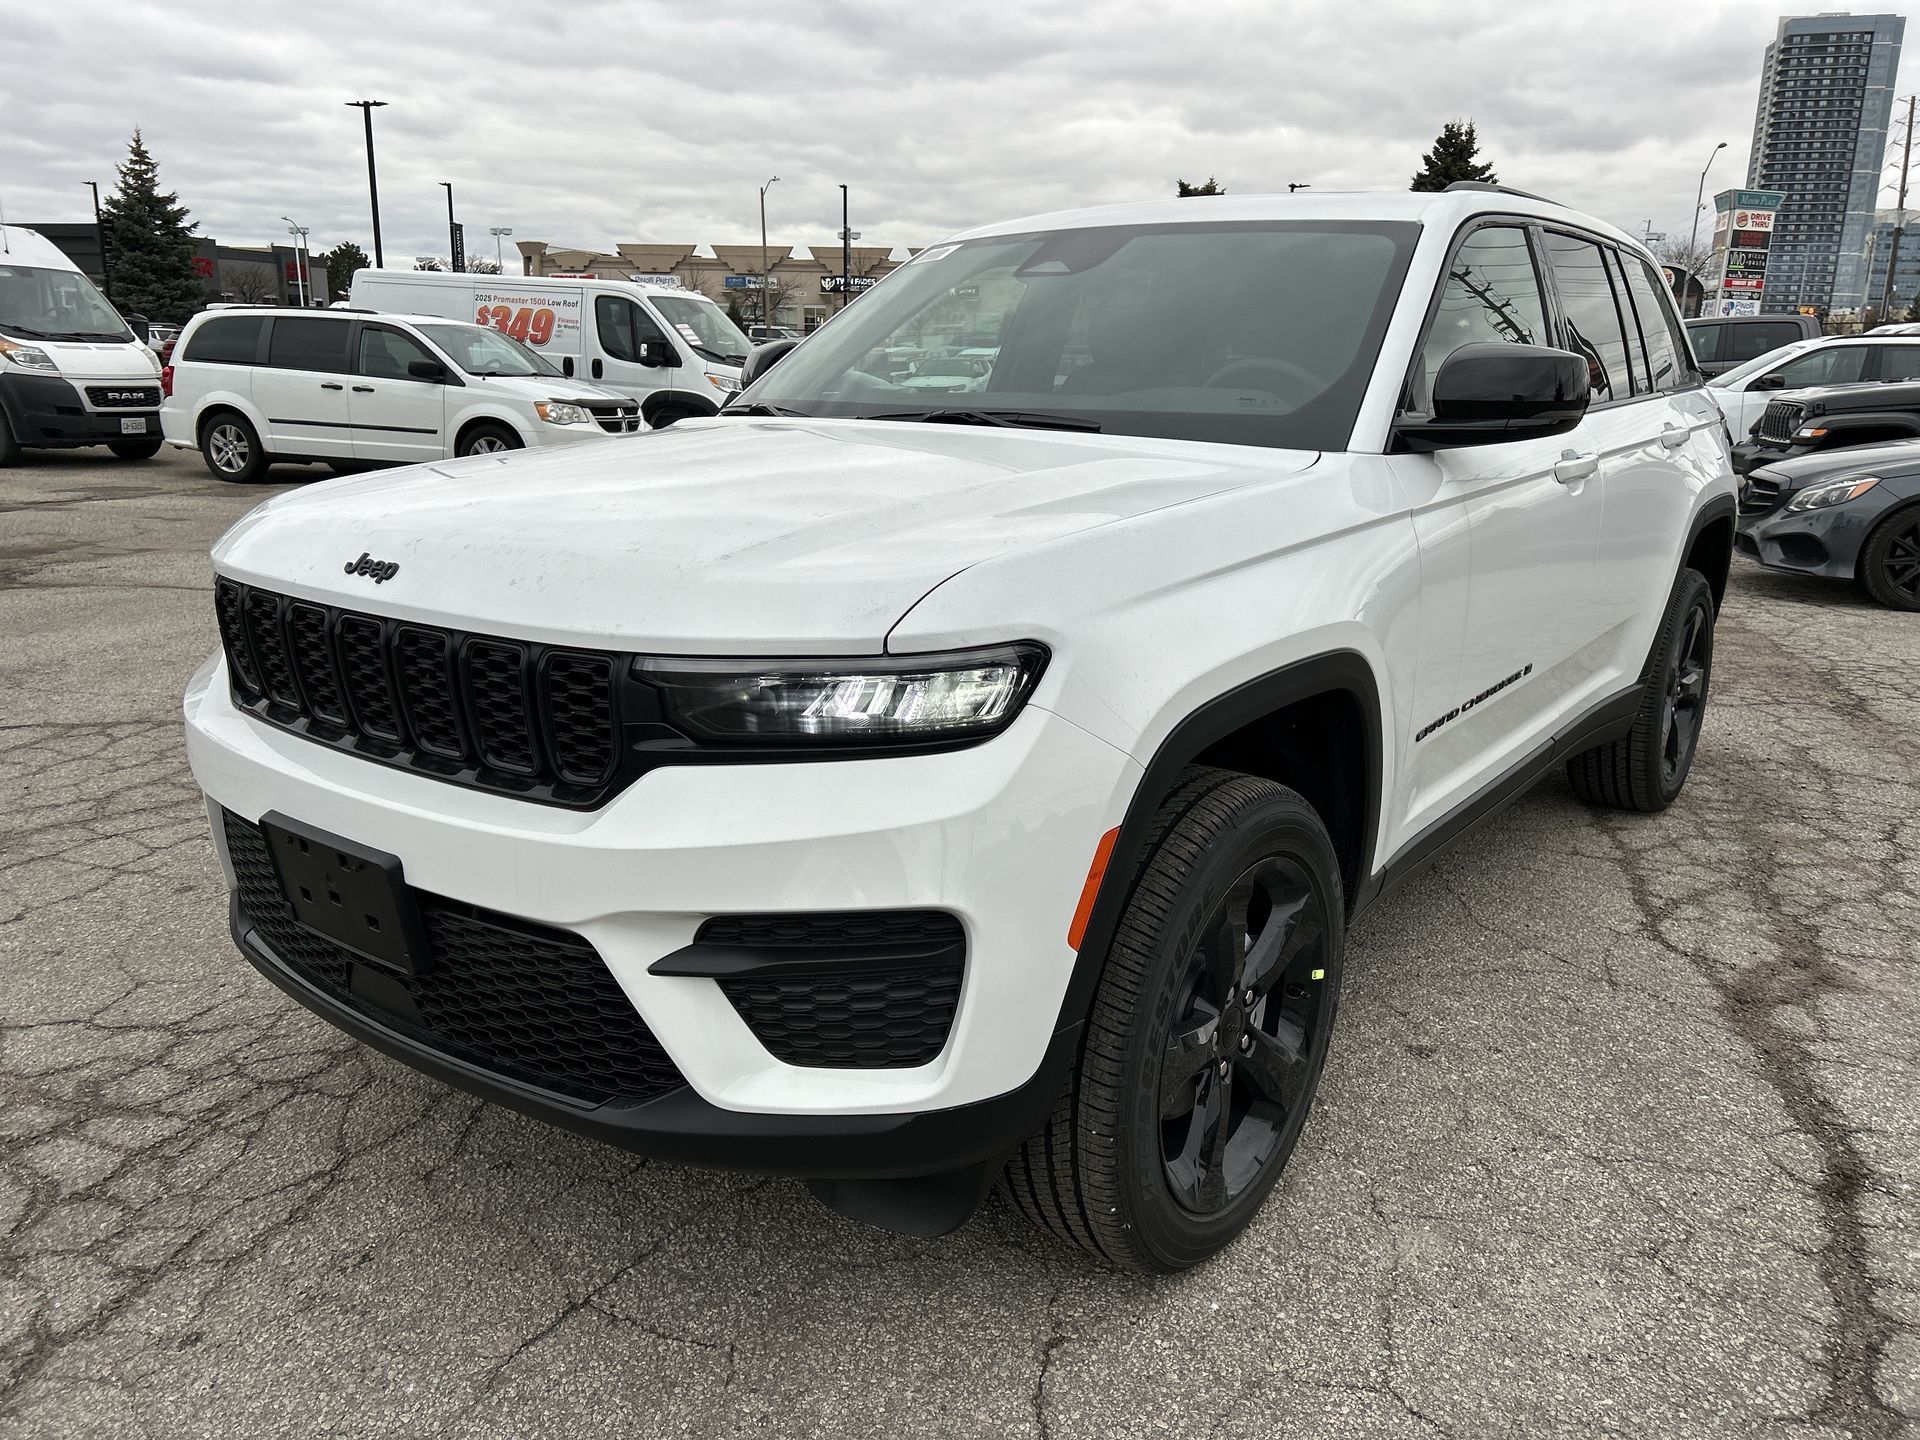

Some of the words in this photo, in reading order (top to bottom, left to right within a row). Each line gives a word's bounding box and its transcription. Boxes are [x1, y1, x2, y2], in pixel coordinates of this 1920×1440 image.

[1750, 212, 1772, 221] DRIVE
[1751, 220, 1770, 228] THRU
[1748, 252, 1765, 260] pizza
[854, 277, 876, 285] FADES
[475, 294, 492, 302] 2025
[493, 295, 529, 304] Promaster
[530, 297, 547, 305] 1500
[562, 299, 579, 308] Roof
[475, 304, 556, 346] $349
[344, 552, 400, 584] Jeep
[1415, 706, 1460, 743] GRAND
[1461, 668, 1524, 713] CHEROKEE
